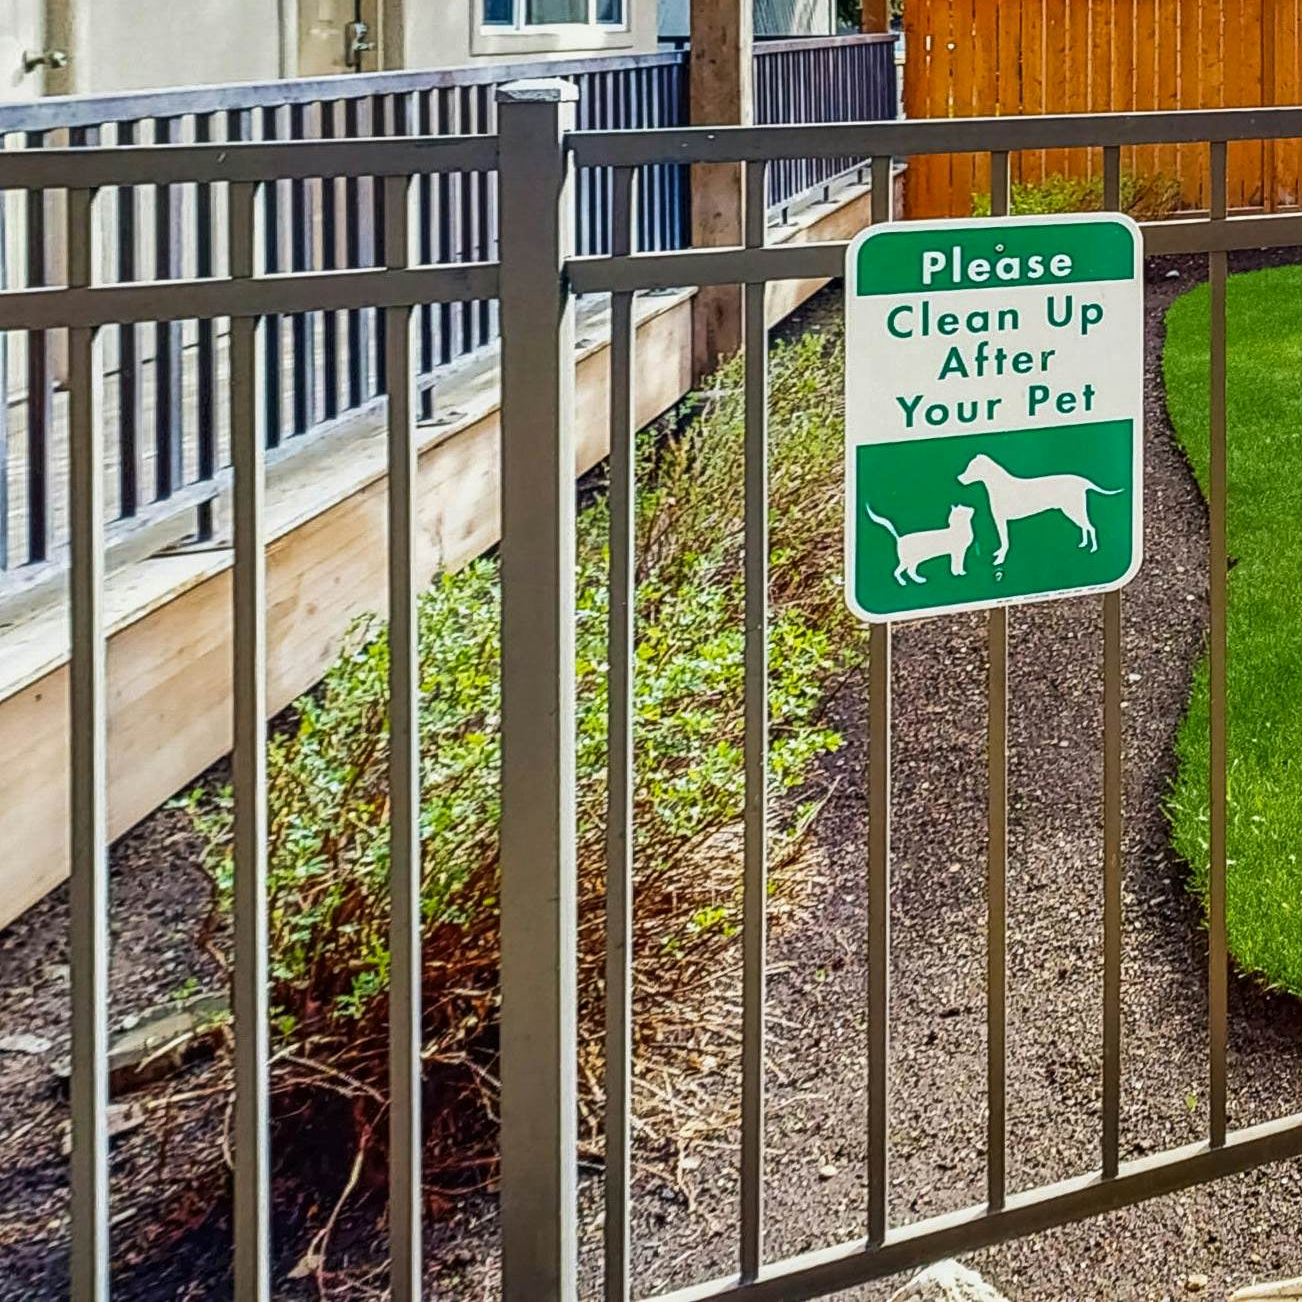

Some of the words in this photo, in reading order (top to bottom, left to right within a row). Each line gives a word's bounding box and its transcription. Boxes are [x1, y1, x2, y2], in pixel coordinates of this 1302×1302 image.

[922, 245, 1073, 285] Please
[886, 300, 1019, 339] Clean
[1047, 295, 1104, 336] Up
[938, 341, 1056, 380] After
[896, 394, 1002, 428] Your
[1028, 384, 1095, 417] Pet
